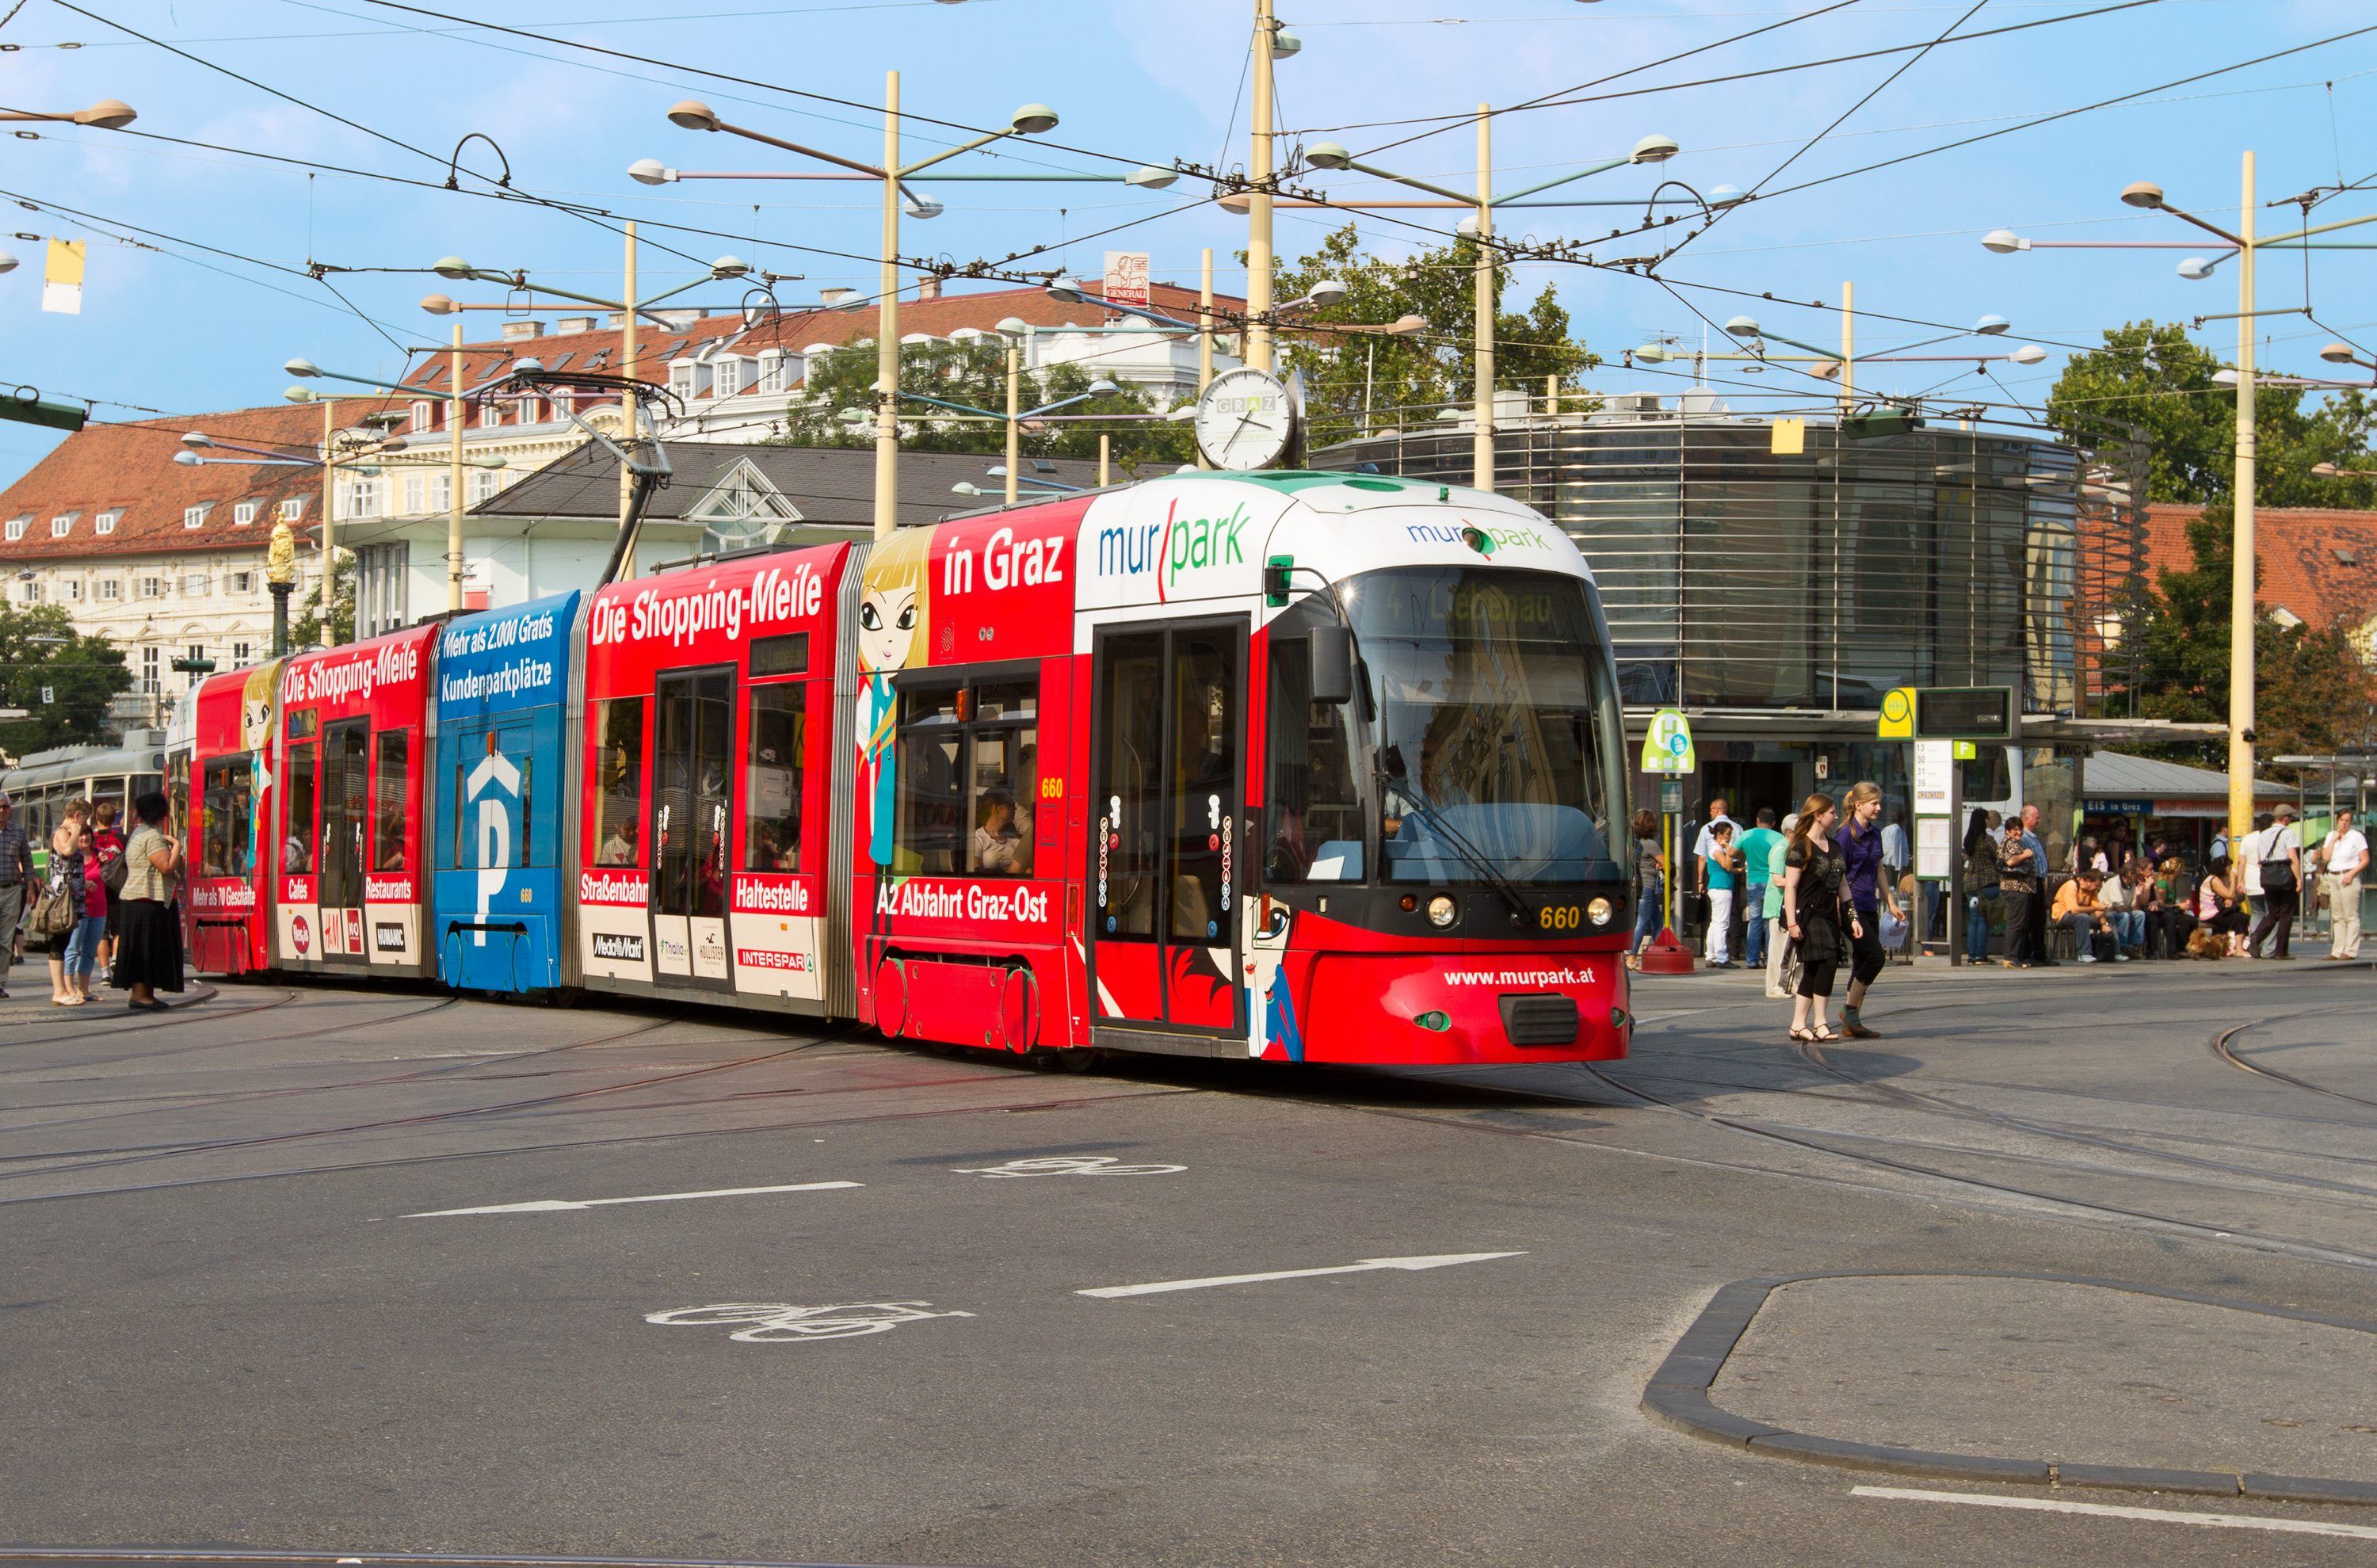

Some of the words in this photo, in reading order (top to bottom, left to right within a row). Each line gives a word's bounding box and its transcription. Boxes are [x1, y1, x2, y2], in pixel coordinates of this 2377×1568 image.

[1108, 289, 1147, 298] GENERALI
[1219, 397, 1273, 412] GRAZ
[944, 536, 973, 596] in
[984, 527, 1064, 591] Graz
[593, 596, 626, 646] Die
[631, 563, 822, 647] Shopping-Meile
[443, 630, 471, 658] Mehr
[471, 625, 486, 654] als
[487, 618, 518, 650] 2.000
[518, 610, 553, 643] Gratis
[284, 665, 305, 704] Die
[307, 640, 418, 704] Shopping-Meile
[442, 658, 551, 703] Kundenparkplätze
[45, 690, 52, 700] E
[1961, 742, 1970, 755] F
[2063, 745, 2081, 756] WC
[1917, 755, 1926, 764] 30
[1042, 777, 1063, 799] 660
[2088, 800, 2105, 811] EIS
[193, 887, 208, 906] Mehr
[208, 887, 218, 906] als
[218, 887, 225, 906] 70
[226, 885, 256, 906] Geschäfte
[288, 878, 307, 900] Cafés
[366, 876, 411, 900] Restaurants
[521, 888, 532, 903] 660
[581, 873, 649, 903] Straßenbahn
[736, 878, 808, 910] Haltestelle
[876, 883, 899, 915] A2
[901, 883, 963, 918] Abfahrt
[967, 884, 1047, 922] Graz-Ost
[1540, 906, 1580, 929] 660
[377, 929, 404, 946] HUMANIC
[700, 945, 723, 960] HOLLISTER
[742, 951, 804, 969] INTERSPAR
[1444, 967, 1596, 987] www.murpark.at
